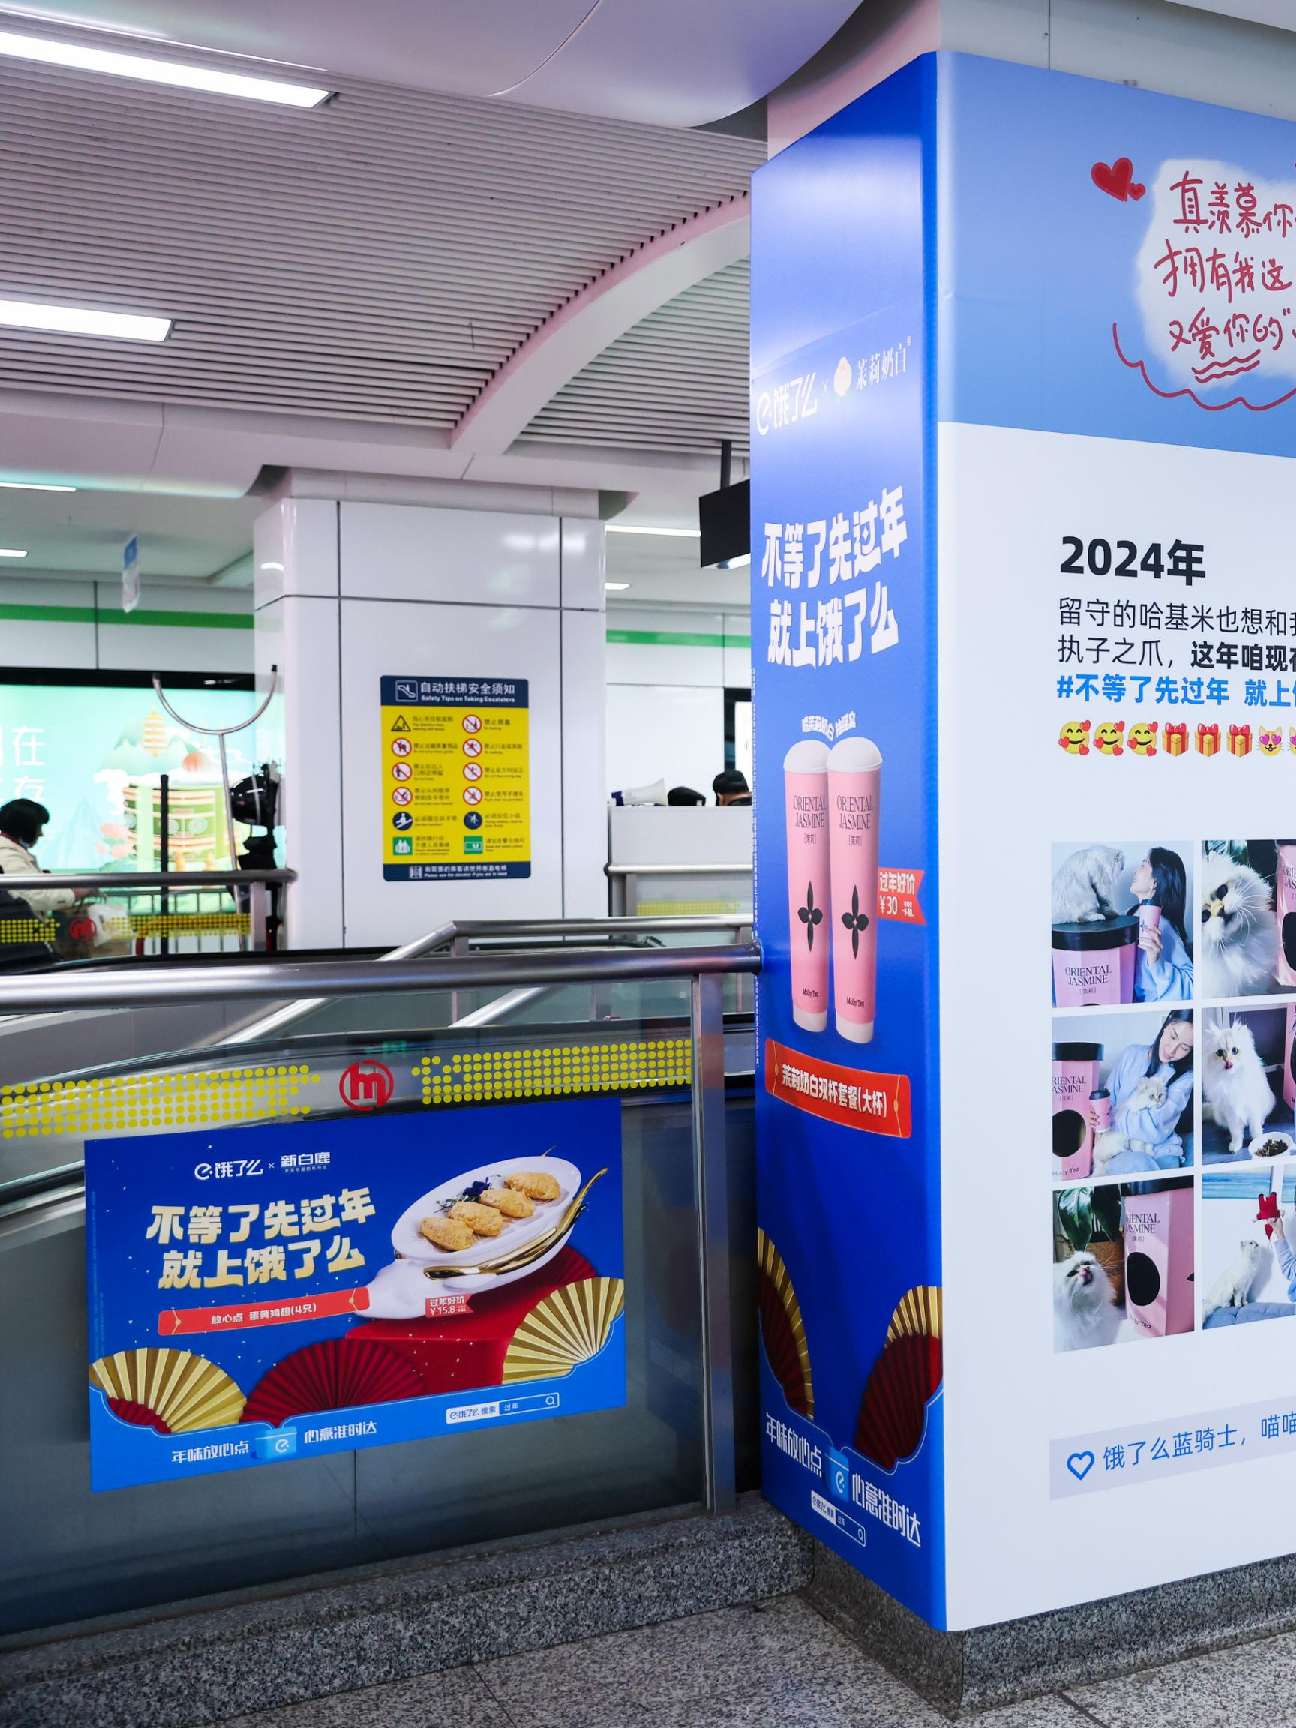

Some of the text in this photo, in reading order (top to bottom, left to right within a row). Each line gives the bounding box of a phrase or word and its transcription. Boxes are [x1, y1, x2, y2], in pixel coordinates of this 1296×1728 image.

[761, 485, 908, 589] 不等了先过年
[1060, 536, 1206, 586] 2024年
[767, 580, 900, 670] 就上饿了么
[421, 682, 516, 696] 自动扶梯安全须知
[1057, 673, 1230, 706] #不等了先过年
[793, 794, 828, 812] ORIENTAL
[837, 794, 873, 812] ORIENTAL
[796, 812, 825, 829] JASMINE
[839, 813, 871, 830] JASMINE
[879, 871, 915, 895] 过年好价
[1064, 965, 1112, 977] ORIENTAL
[1068, 975, 1111, 987] JASMINE
[280, 1151, 331, 1168] 新白鹿
[145, 1186, 377, 1246] 不等了先过年
[157, 1235, 366, 1290] 就上饿了么
[210, 1311, 244, 1325] 放心点
[171, 1420, 379, 1465] 年味放心点 心意准时达
[766, 1412, 823, 1479] 年味放心点
[852, 1472, 921, 1548] 心意准时达
